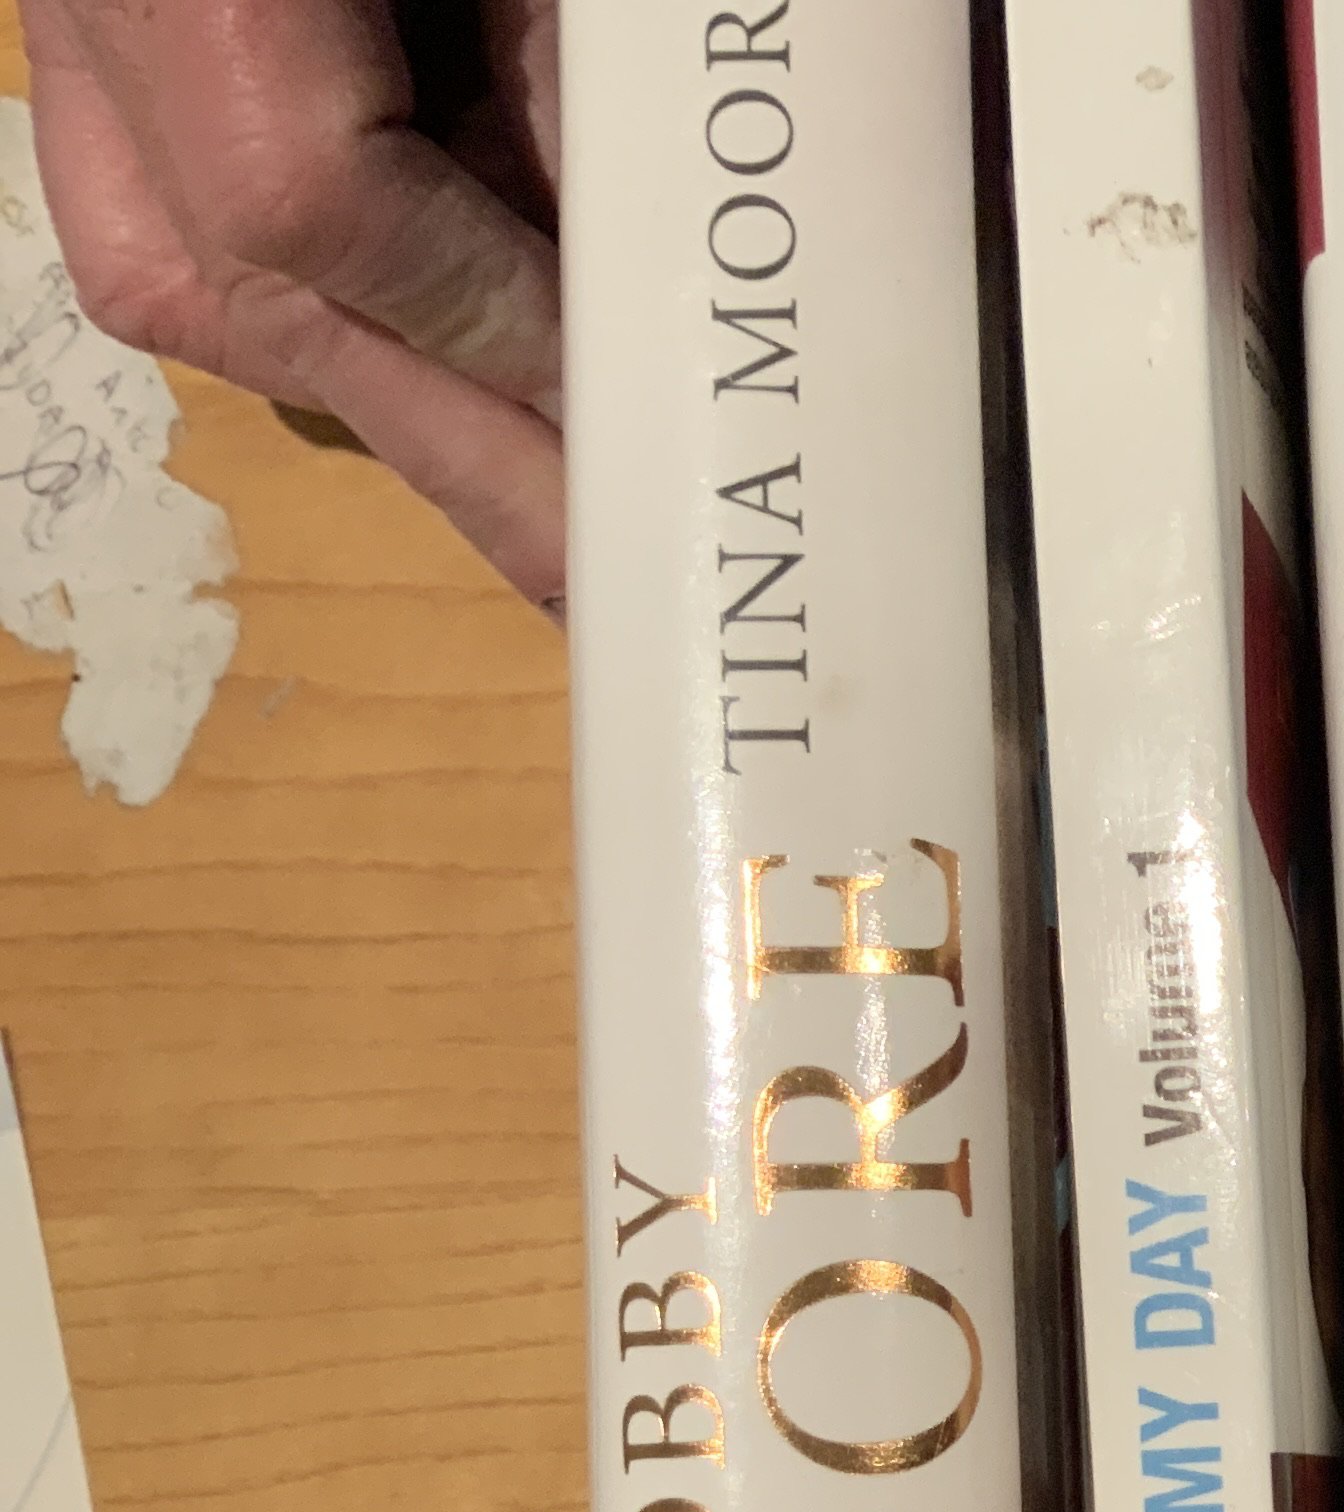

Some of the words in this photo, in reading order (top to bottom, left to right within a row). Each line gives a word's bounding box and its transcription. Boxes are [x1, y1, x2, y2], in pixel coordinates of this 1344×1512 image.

[717, 453, 811, 776] TINA
[1138, 900, 1206, 1147] Volume
[1124, 1178, 1217, 1352] DAY
